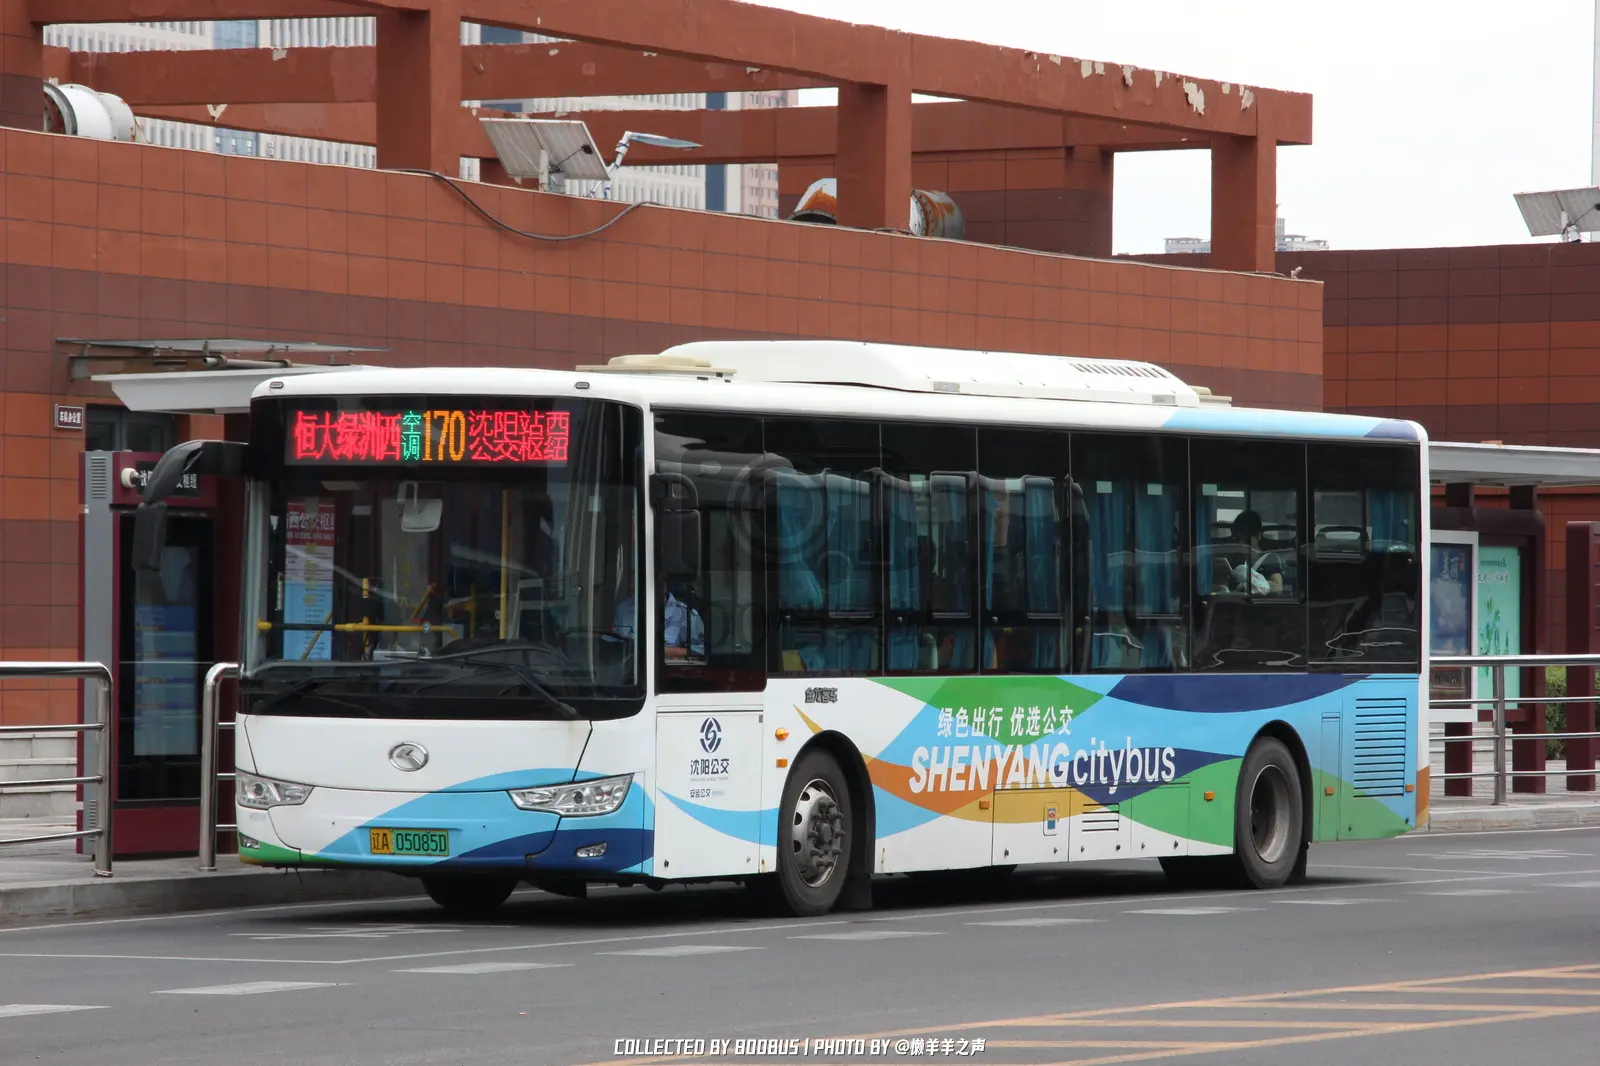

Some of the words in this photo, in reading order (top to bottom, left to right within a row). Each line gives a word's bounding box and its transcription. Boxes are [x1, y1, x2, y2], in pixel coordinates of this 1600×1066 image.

[293, 411, 402, 461] 恒大绿洲西
[401, 411, 422, 461] 空调
[422, 410, 466, 461] 170
[468, 410, 571, 437] 沈阳站西
[468, 436, 569, 462] 公交枢纽
[937, 706, 1004, 738] 绿色出行
[1010, 705, 1074, 736] 优选公交
[690, 758, 730, 775] 沈阳公交
[908, 742, 1071, 794] SHENYANG
[1072, 736, 1176, 795] citybus
[372, 832, 391, 851] 辽A
[395, 833, 448, 852] 05085D
